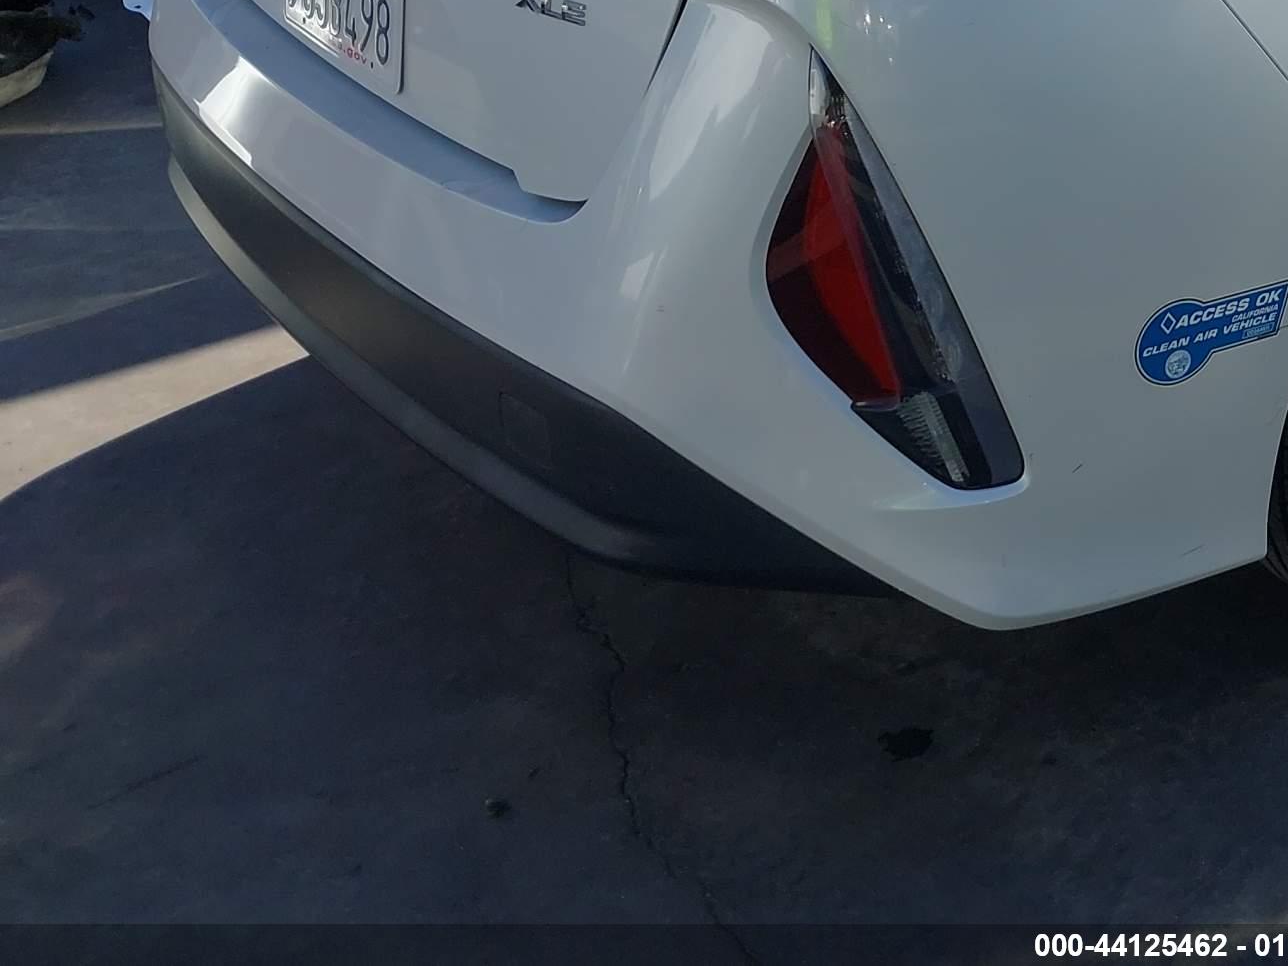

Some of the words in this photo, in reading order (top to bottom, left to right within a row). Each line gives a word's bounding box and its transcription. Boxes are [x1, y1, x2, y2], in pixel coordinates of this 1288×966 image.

[1174, 297, 1250, 329] ACCESS
[1255, 288, 1284, 306] OK
[1231, 304, 1279, 322] CALIFORNIA
[1142, 336, 1191, 357] CLEAN
[1193, 328, 1218, 343] AIR
[1223, 312, 1278, 334] VEHICLE
